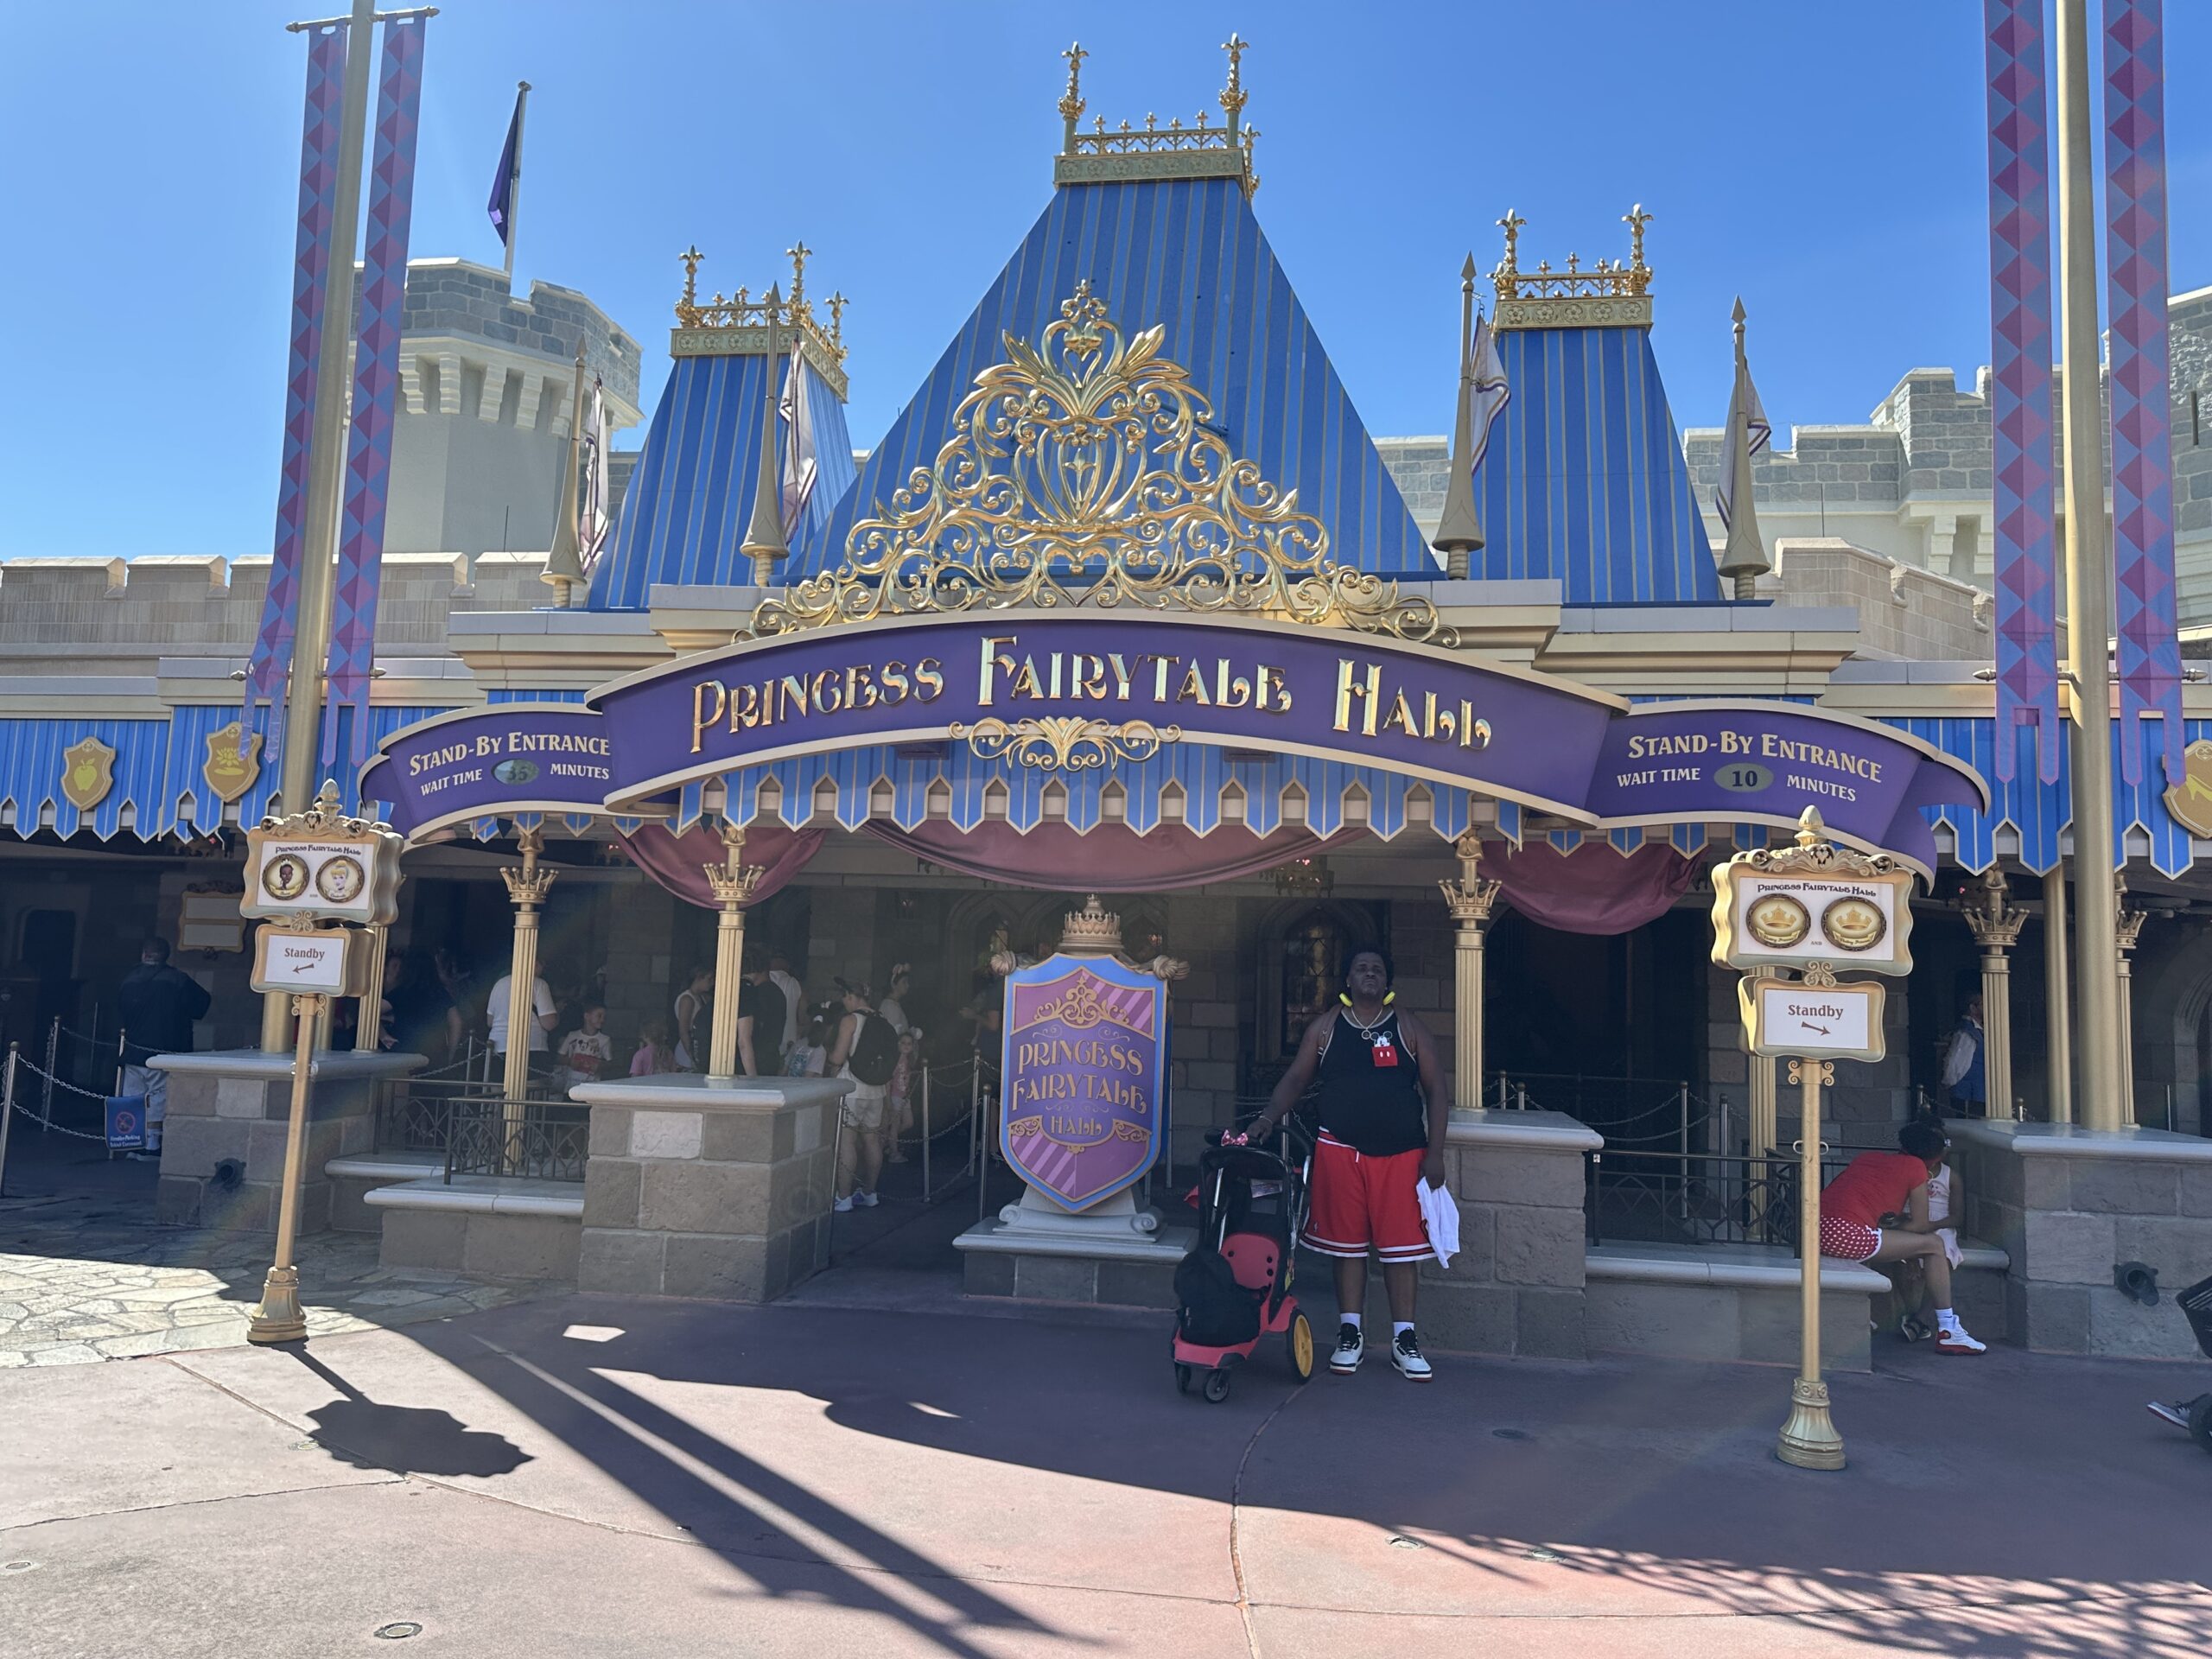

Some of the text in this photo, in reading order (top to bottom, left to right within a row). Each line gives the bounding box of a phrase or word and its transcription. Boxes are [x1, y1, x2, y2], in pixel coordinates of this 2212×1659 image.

[690, 635, 1492, 753] PRINCESS FAIRYTALE HALL
[409, 731, 611, 776] STAND-BY ENTRANCE
[1627, 730, 1883, 783] STAND-BY ENTRANCE
[420, 777, 450, 796] WAIT
[452, 769, 482, 786] TIME
[550, 763, 610, 779] MINUTES
[1617, 767, 1857, 802] WAIT TIME 10 MINUTES
[1758, 882, 1877, 897] PRINCESS FAIRYTALE HALL
[284, 947, 325, 962] Standby
[1788, 1004, 1844, 1020] Standby
[1018, 1039, 1144, 1077] PRINCESS
[1011, 1073, 1147, 1115] FAIRYTALE
[1050, 1116, 1103, 1136] HALL
